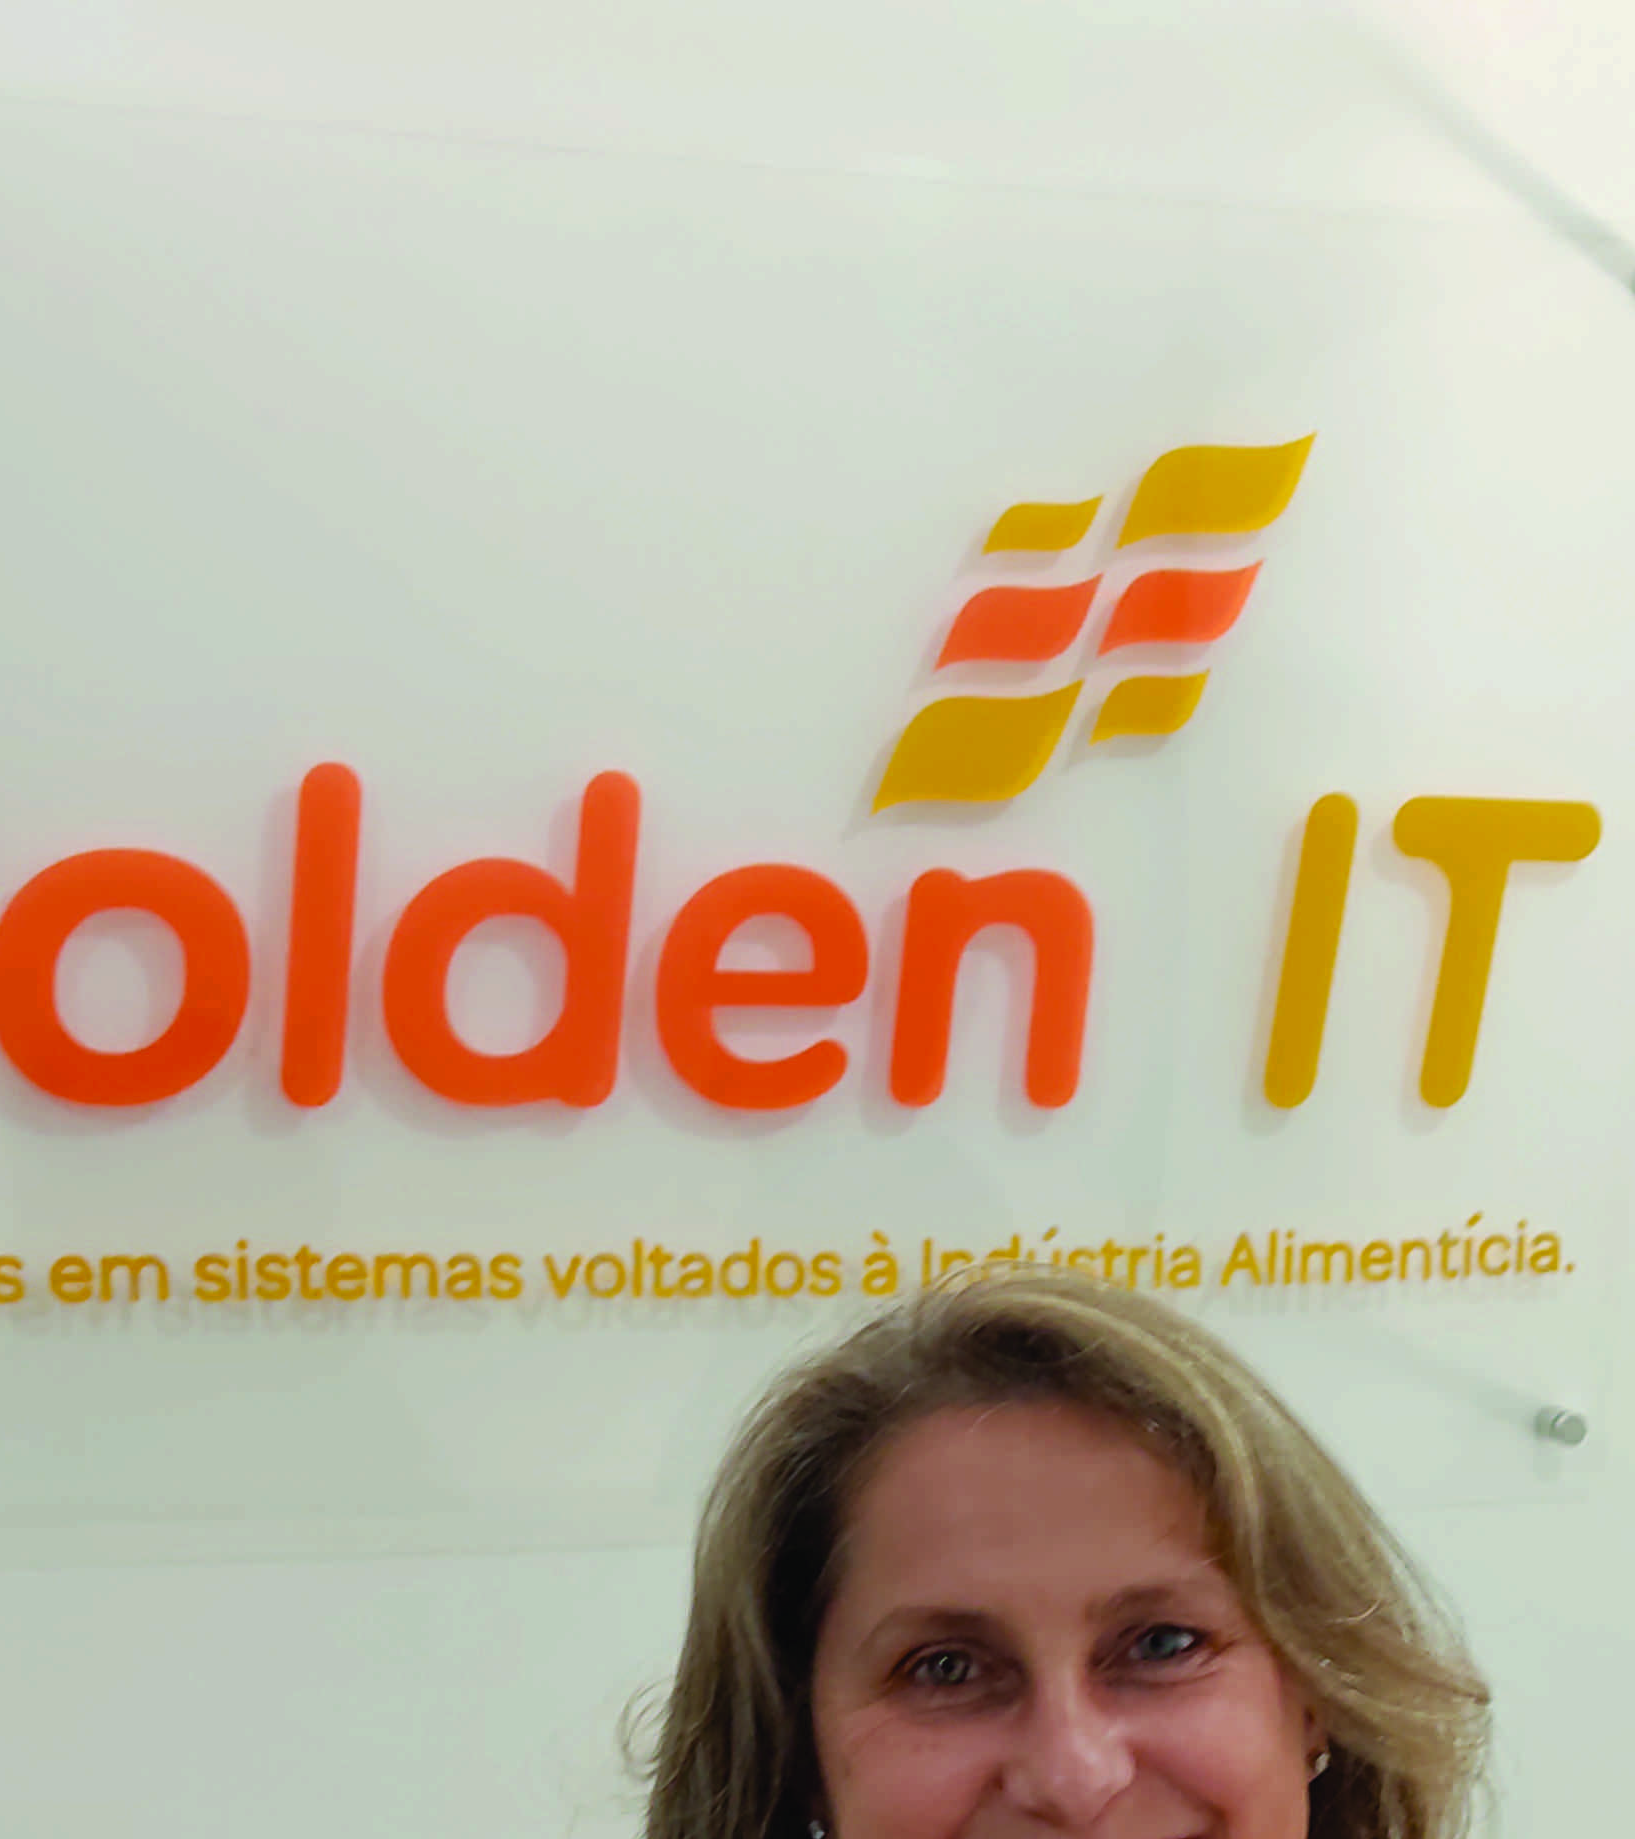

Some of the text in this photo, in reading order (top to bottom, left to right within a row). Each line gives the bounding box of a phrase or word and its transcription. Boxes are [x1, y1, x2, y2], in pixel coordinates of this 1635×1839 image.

[1265, 790, 1602, 1109] IT
[49, 1251, 167, 1304] em
[194, 1240, 524, 1302] sistemas
[544, 1237, 842, 1300] voltados
[861, 1231, 900, 1293] à
[1220, 1212, 1576, 1285] Alimentícia.
